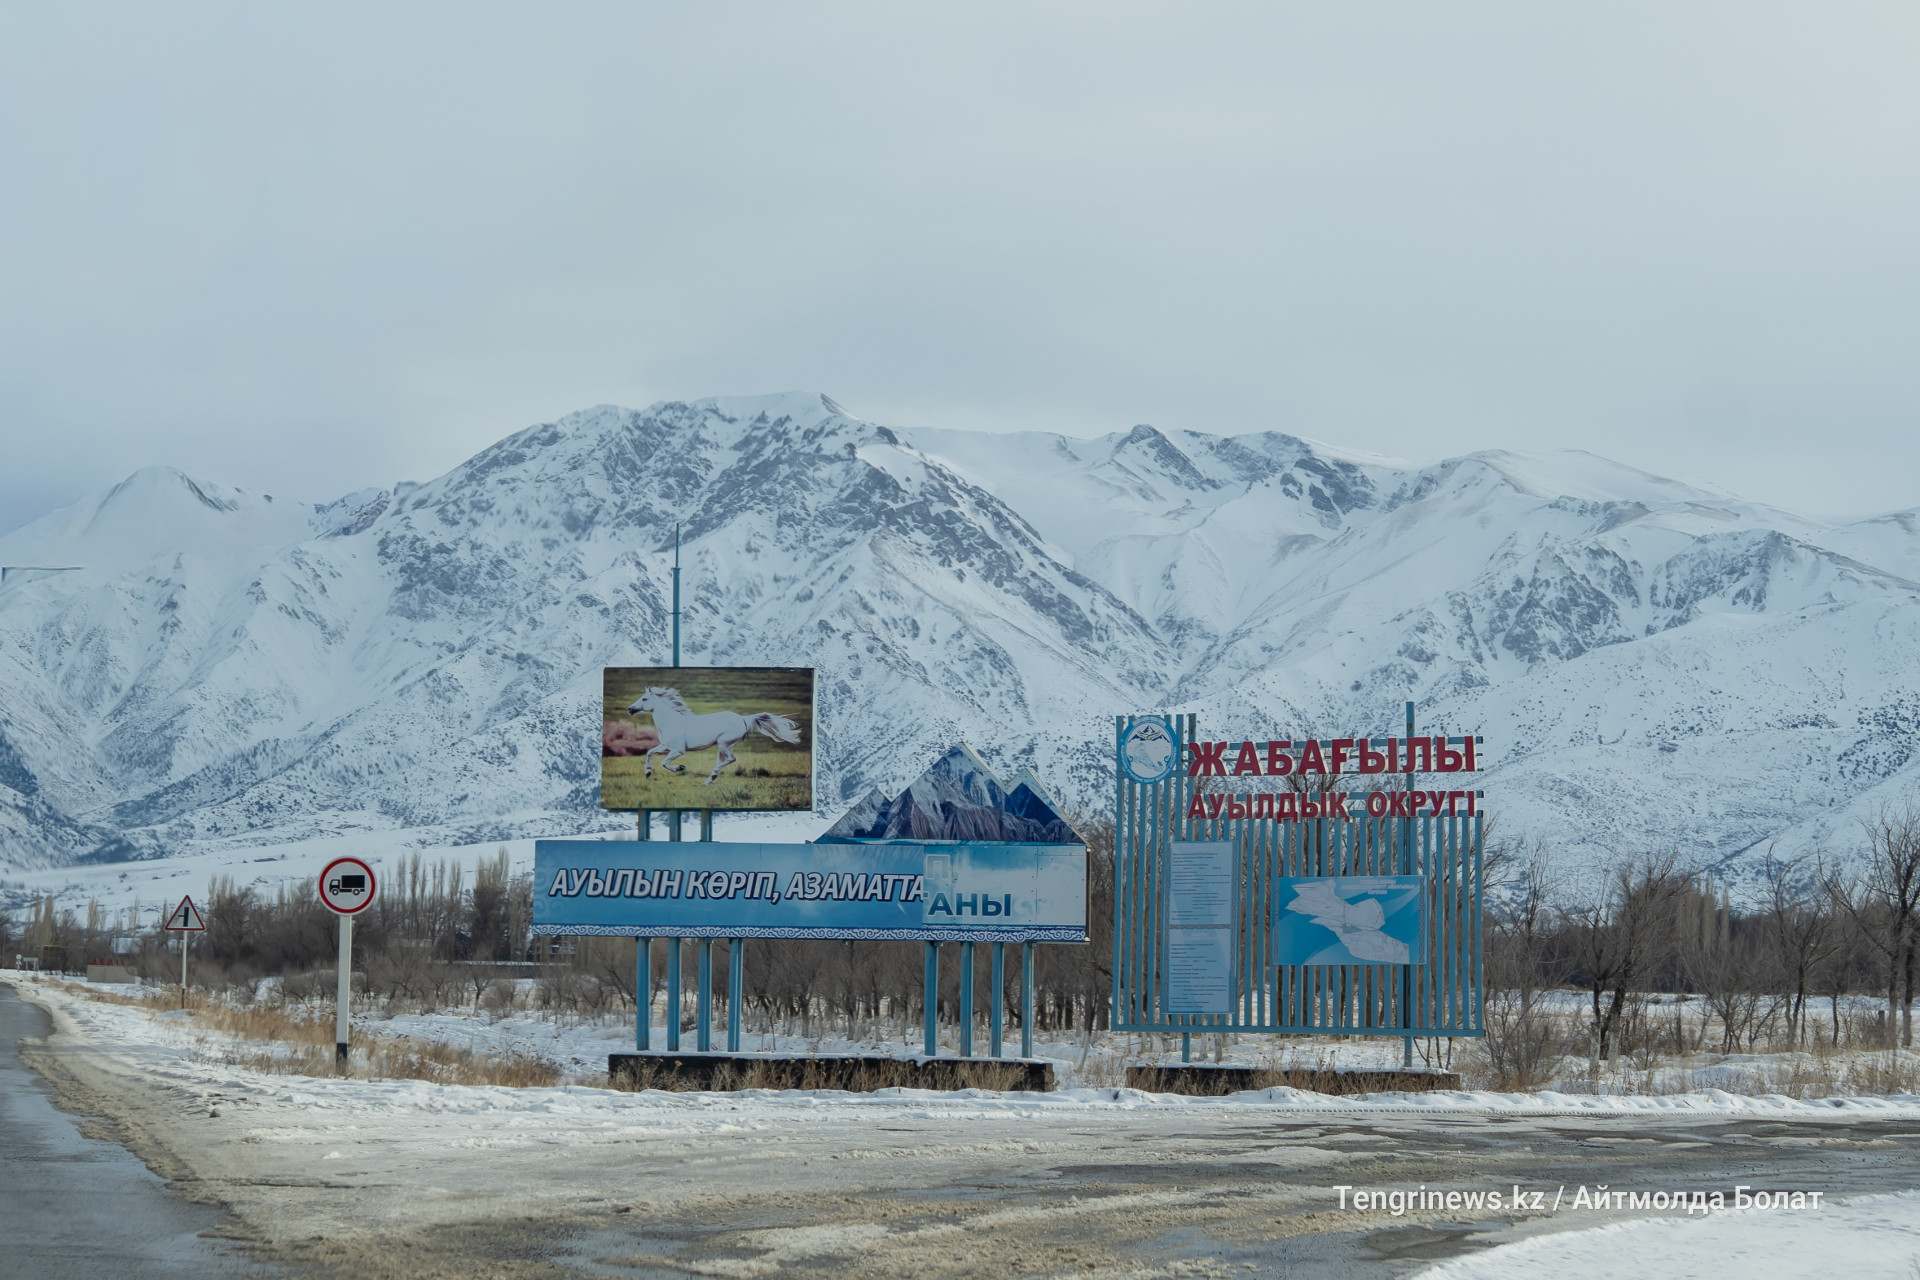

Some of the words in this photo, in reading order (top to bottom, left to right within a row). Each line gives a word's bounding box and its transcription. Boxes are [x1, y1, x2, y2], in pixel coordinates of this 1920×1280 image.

[1188, 736, 1477, 776] ЖАБАҒЫЛЫ
[1187, 792, 1351, 823] АУЫЛДЫҚ
[1366, 791, 1477, 818] ОКРУГІ
[549, 868, 682, 899] АУЫЛЫН
[685, 870, 781, 904] КӨРІП,
[923, 891, 1012, 917] АНЫ
